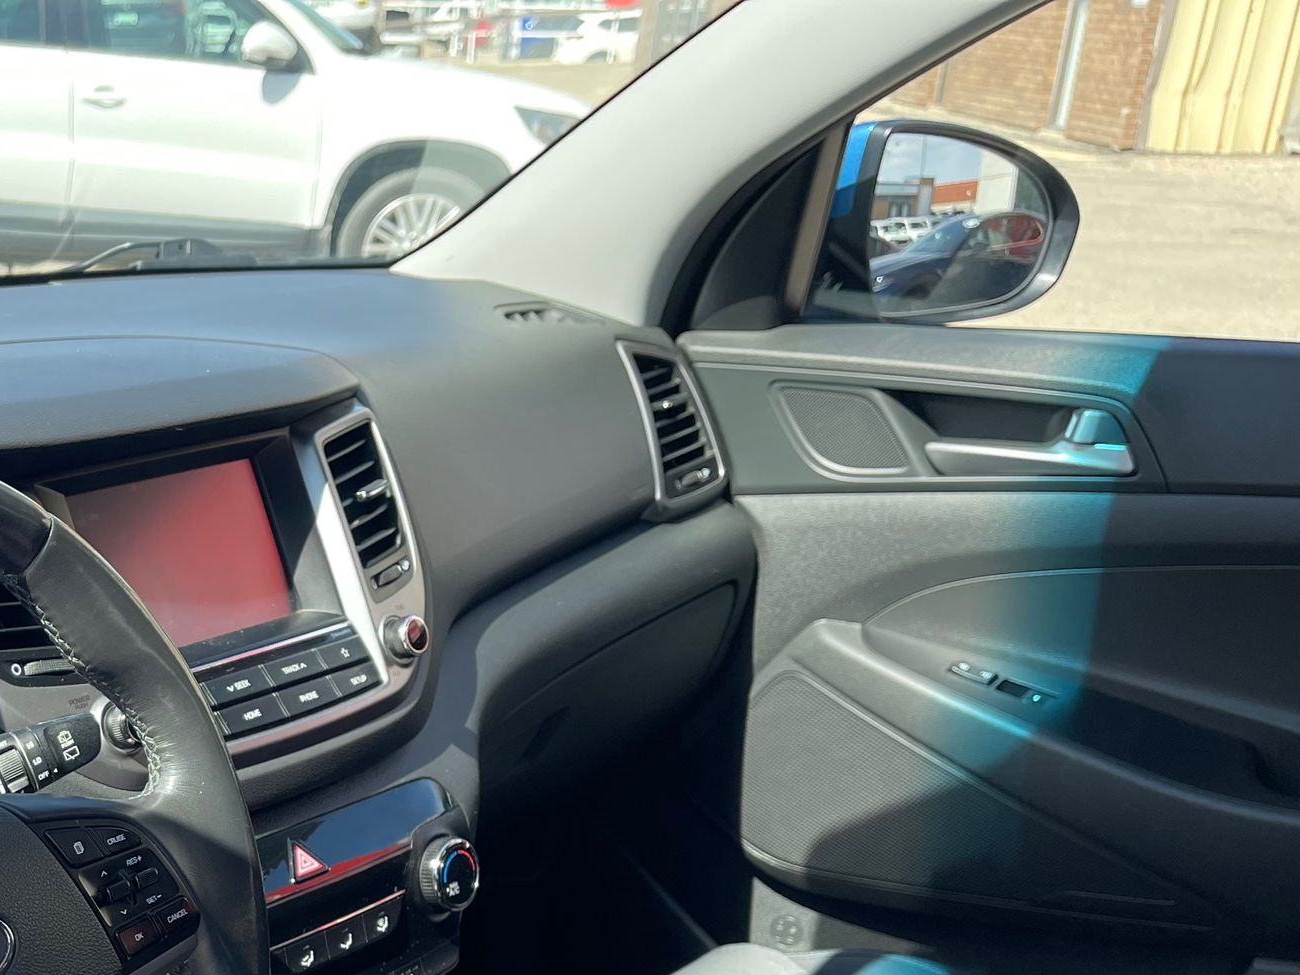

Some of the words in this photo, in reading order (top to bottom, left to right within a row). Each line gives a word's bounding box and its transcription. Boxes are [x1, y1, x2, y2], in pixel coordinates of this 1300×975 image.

[38, 771, 49, 780] OFF
[107, 834, 125, 845] CRUISE
[167, 909, 189, 924] CANCEL
[135, 932, 143, 941] OK
